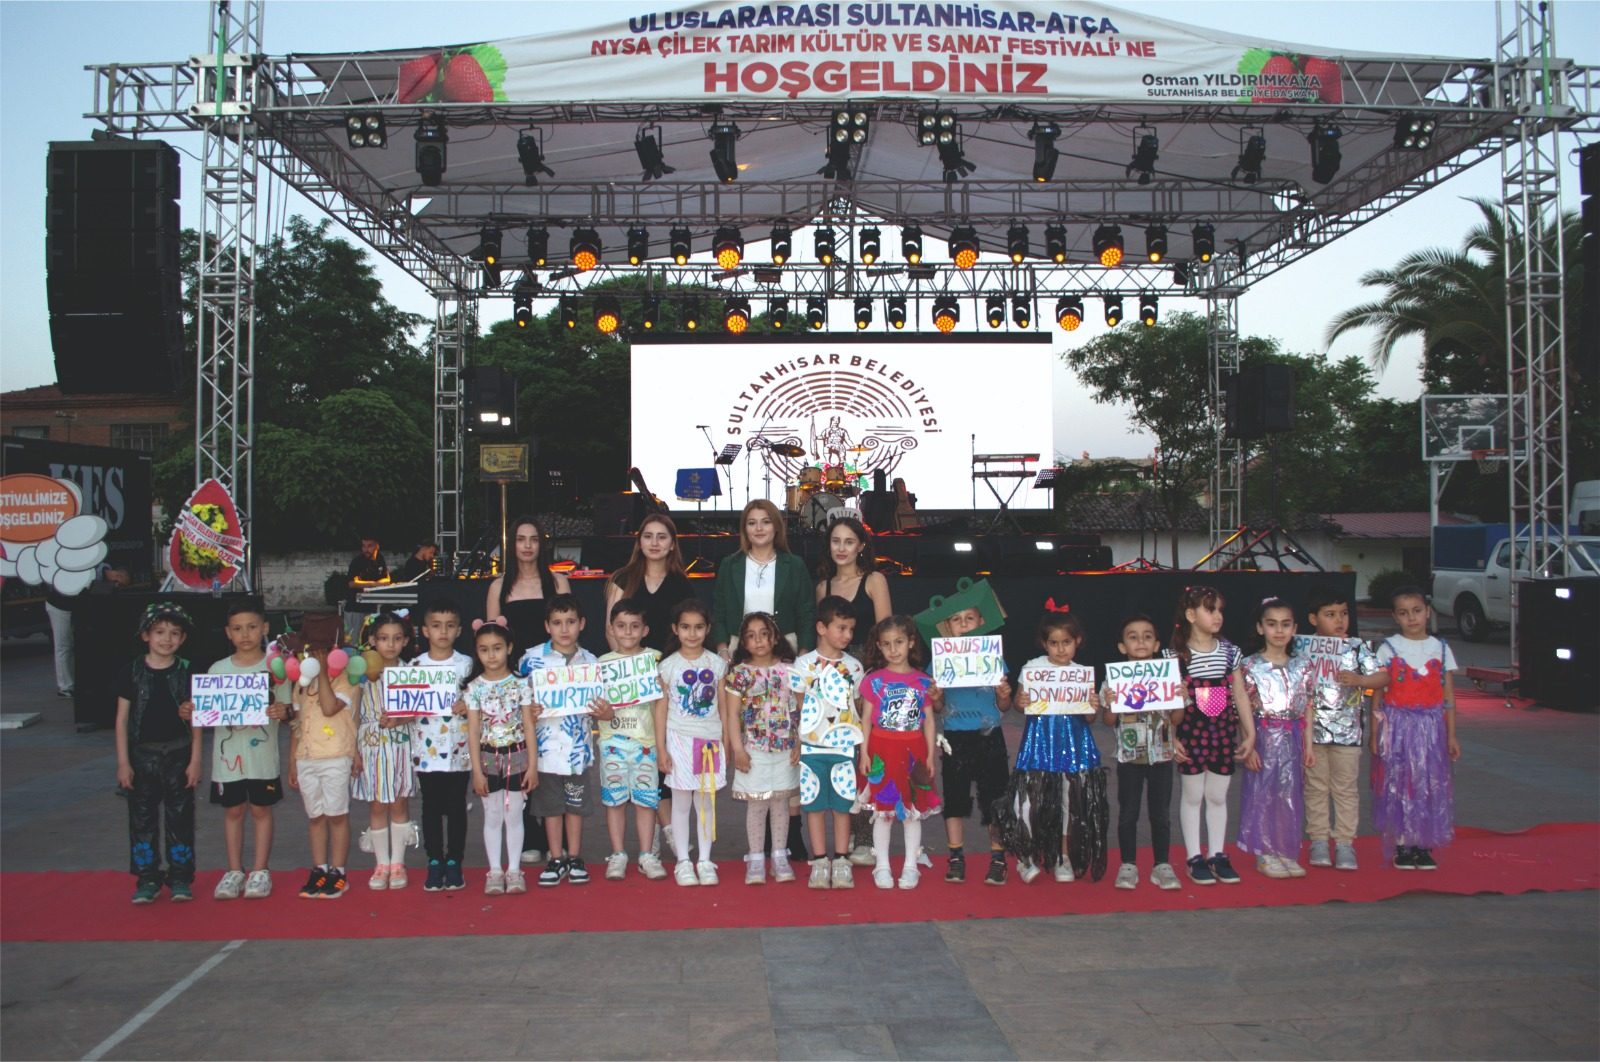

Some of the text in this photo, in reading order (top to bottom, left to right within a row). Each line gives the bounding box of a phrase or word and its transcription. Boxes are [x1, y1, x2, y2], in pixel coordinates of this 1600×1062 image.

[629, 3, 840, 33] ULUSLARARASI
[591, 37, 651, 56] NYSA
[658, 31, 721, 58] ÇİLEK
[727, 34, 794, 53] TARIM
[801, 29, 886, 53] KÜLTÜR
[892, 34, 922, 52] VE
[927, 34, 1002, 53] SANAT
[1126, 41, 1156, 57] NE
[704, 54, 1048, 99] HOŞGELDİNİZ
[1142, 74, 1321, 87] Osman YILDIRIMKAYA
[1147, 88, 1319, 98] SULTANHİSAR BELEDİYE BAŞKANI
[850, 355, 942, 433] BELEDİYESİ
[235, 671, 269, 691] DOĞA
[386, 668, 427, 685] DOĞA
[601, 658, 631, 683] EŞİL
[1109, 662, 1170, 680] DOĞAYI
[386, 689, 436, 712] HAYAT
[606, 680, 639, 705] ÖPÜ
[1115, 681, 1175, 704] KORU
[221, 712, 244, 725] AM
